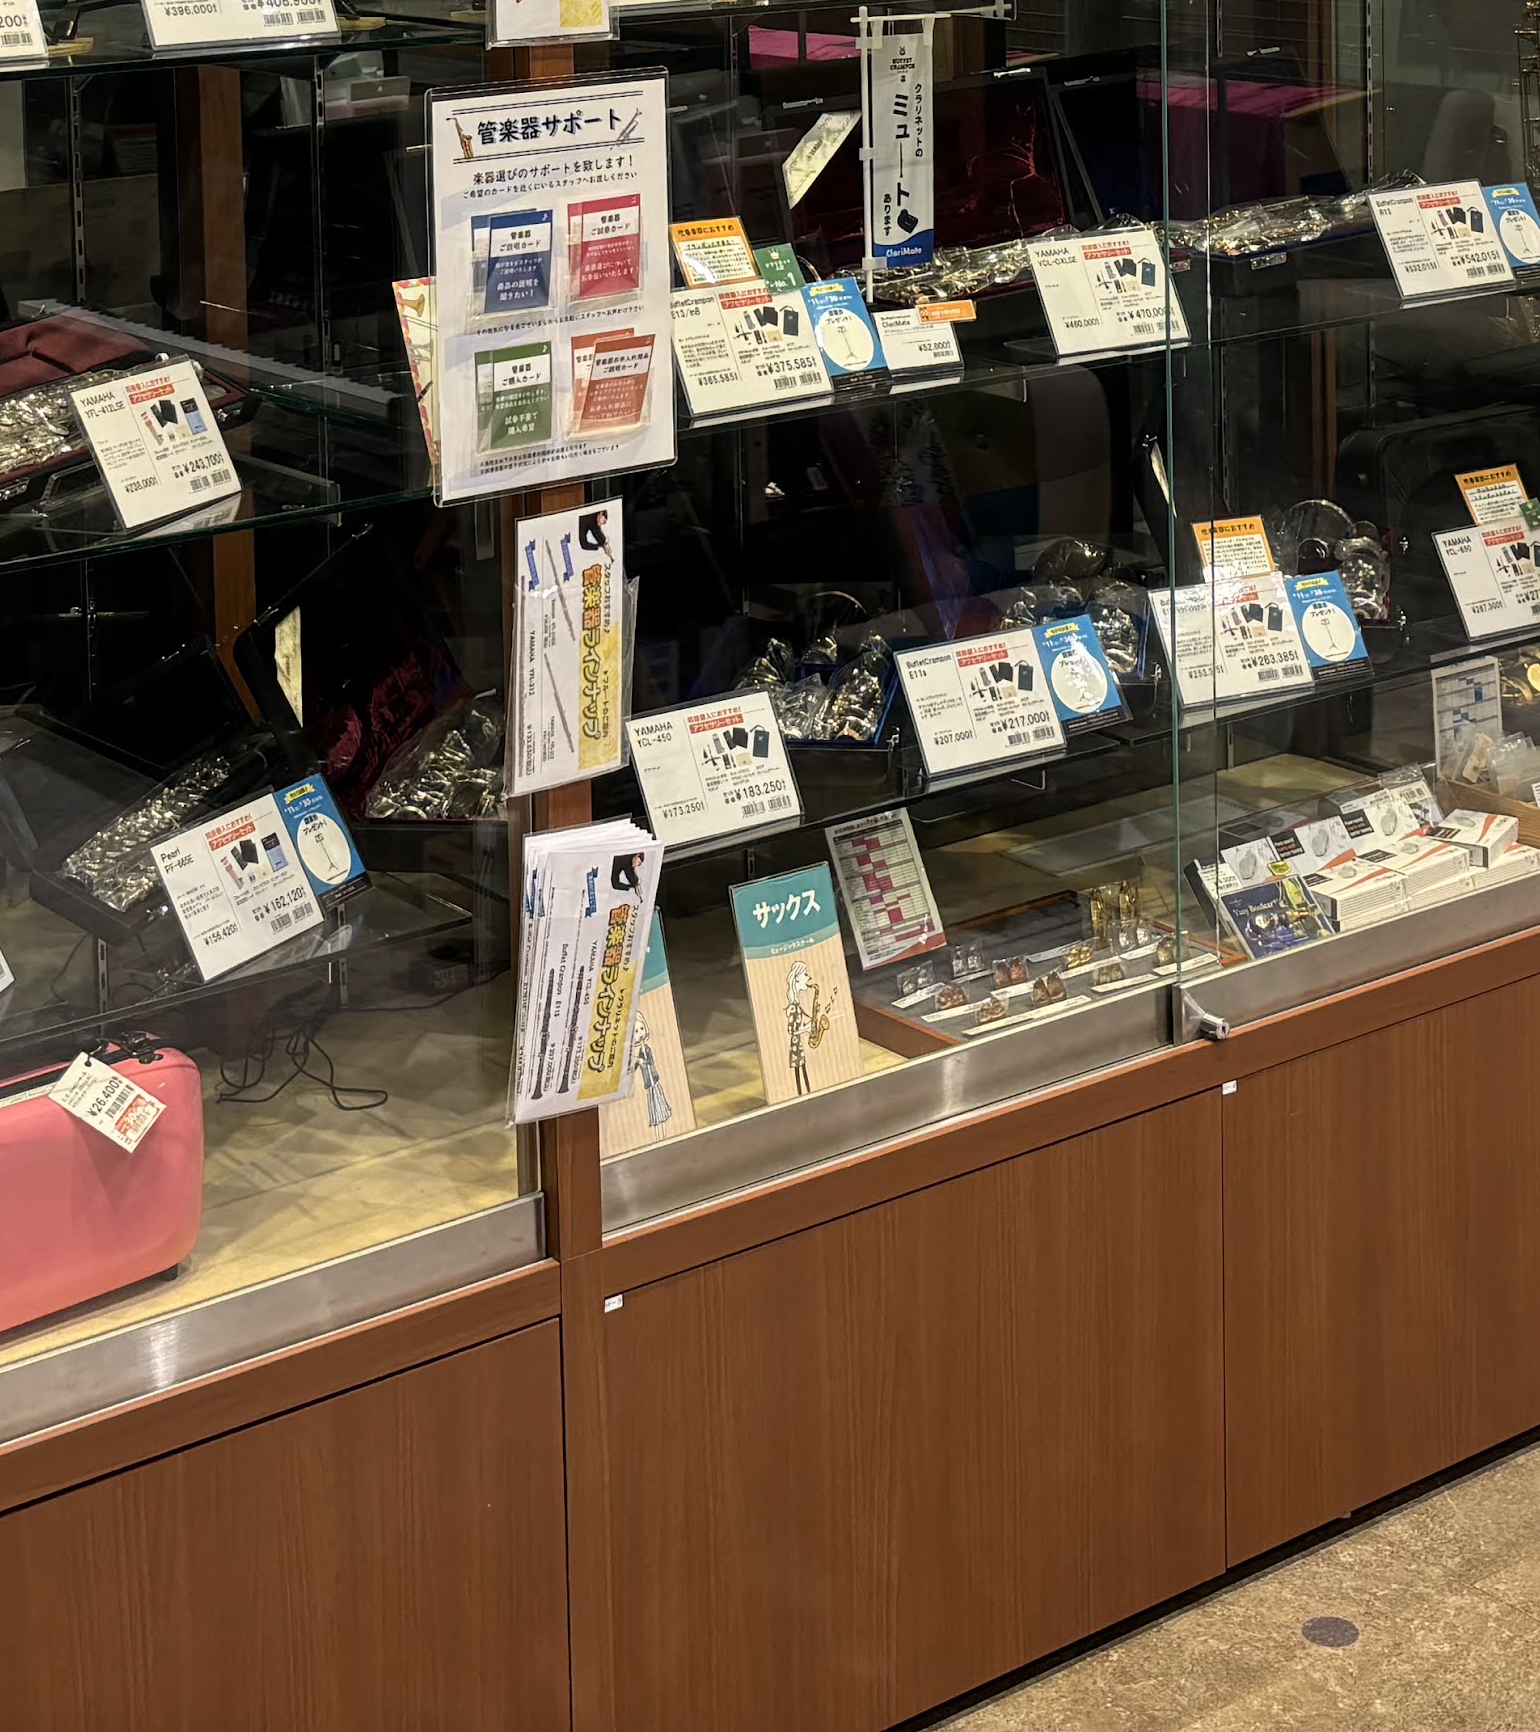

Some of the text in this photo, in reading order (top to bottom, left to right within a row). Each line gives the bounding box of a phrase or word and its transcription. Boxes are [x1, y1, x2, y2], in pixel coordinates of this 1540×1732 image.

[477, 109, 621, 145] 管楽器サポート
[914, 84, 924, 158] クラリネットの
[473, 156, 634, 186] 楽器選びのサポートを致します!
[882, 193, 891, 236] あります
[886, 245, 923, 258] ClariMate
[1034, 247, 1070, 258] YAMAHA
[80, 391, 115, 407] YAMAHA
[1442, 535, 1472, 548] YAMAHA
[582, 563, 602, 740] 管楽器ラインナップ
[634, 721, 673, 737] YAMAHA
[637, 733, 672, 748] YCL-450
[161, 849, 181, 862] Pearl
[752, 890, 821, 929] サックス
[588, 903, 631, 1073] 管楽器ラインナップ
[87, 1079, 120, 1116] ¥26,400
